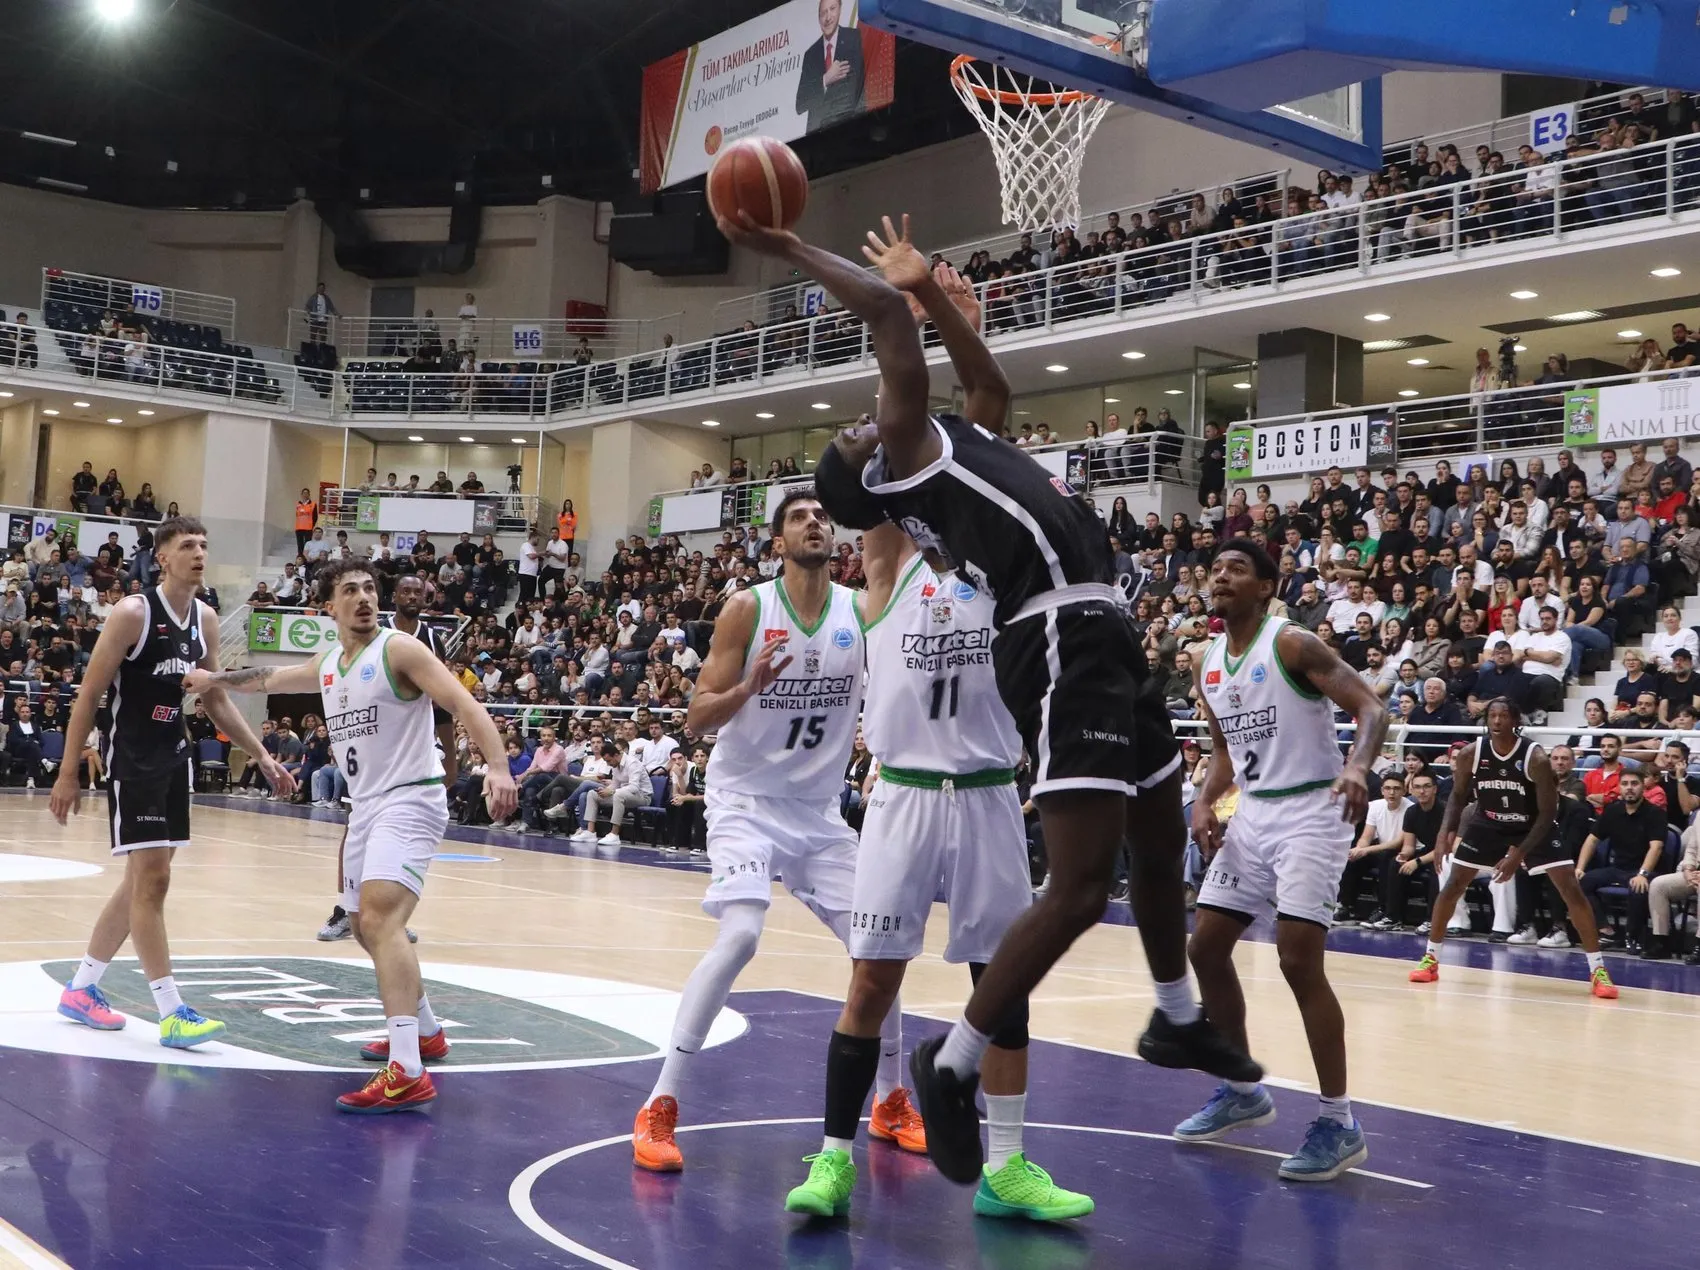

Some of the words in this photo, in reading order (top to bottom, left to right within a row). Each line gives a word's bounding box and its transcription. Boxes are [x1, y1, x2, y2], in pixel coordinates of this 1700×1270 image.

[702, 58, 720, 82] TÜM
[722, 29, 790, 73] TAKIMLARIMIZA
[747, 52, 801, 87] Dilerim
[1534, 112, 1567, 147] E3
[133, 288, 160, 310] H5
[514, 330, 541, 349] H6
[1604, 418, 1665, 439] ANIM
[1257, 422, 1361, 460] BOSTON
[397, 536, 415, 550] D5
[810, 696, 850, 710] BASKET
[929, 675, 959, 720] 11
[347, 725, 379, 740] BASKET
[785, 714, 828, 750] 15
[1243, 727, 1278, 743] BASKET
[346, 746, 358, 777] 6
[1243, 750, 1260, 781] 2
[1501, 796, 1509, 808] 1
[852, 911, 902, 932] OSTON
